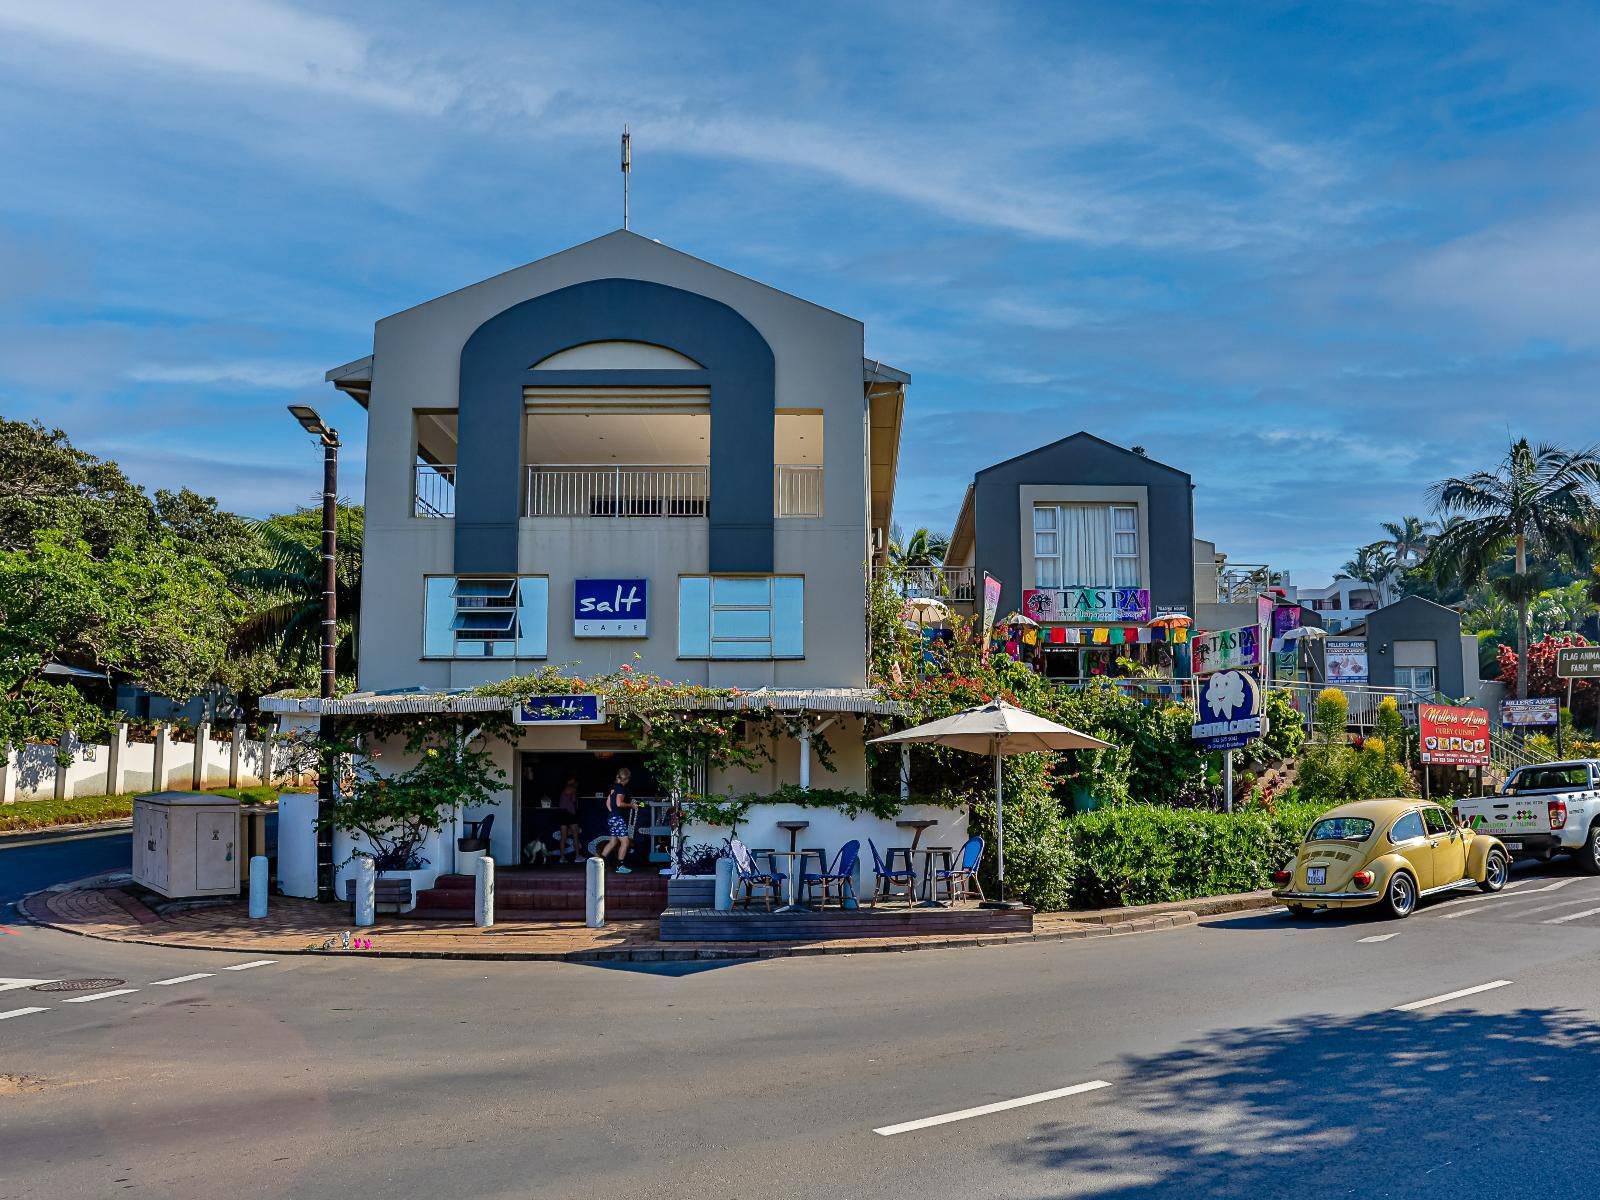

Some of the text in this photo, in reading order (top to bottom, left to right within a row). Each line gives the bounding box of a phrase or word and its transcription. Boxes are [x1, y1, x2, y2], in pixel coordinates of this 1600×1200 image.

[580, 585, 641, 612] salt
[1057, 591, 1143, 609] TASPA
[1209, 630, 1256, 653] TASPA
[1562, 651, 1600, 661] FLAG ANIMA
[1570, 663, 1588, 672] FARM
[1423, 707, 1487, 729] Millers Arms
[1435, 727, 1476, 737] CURRY CUISINE
